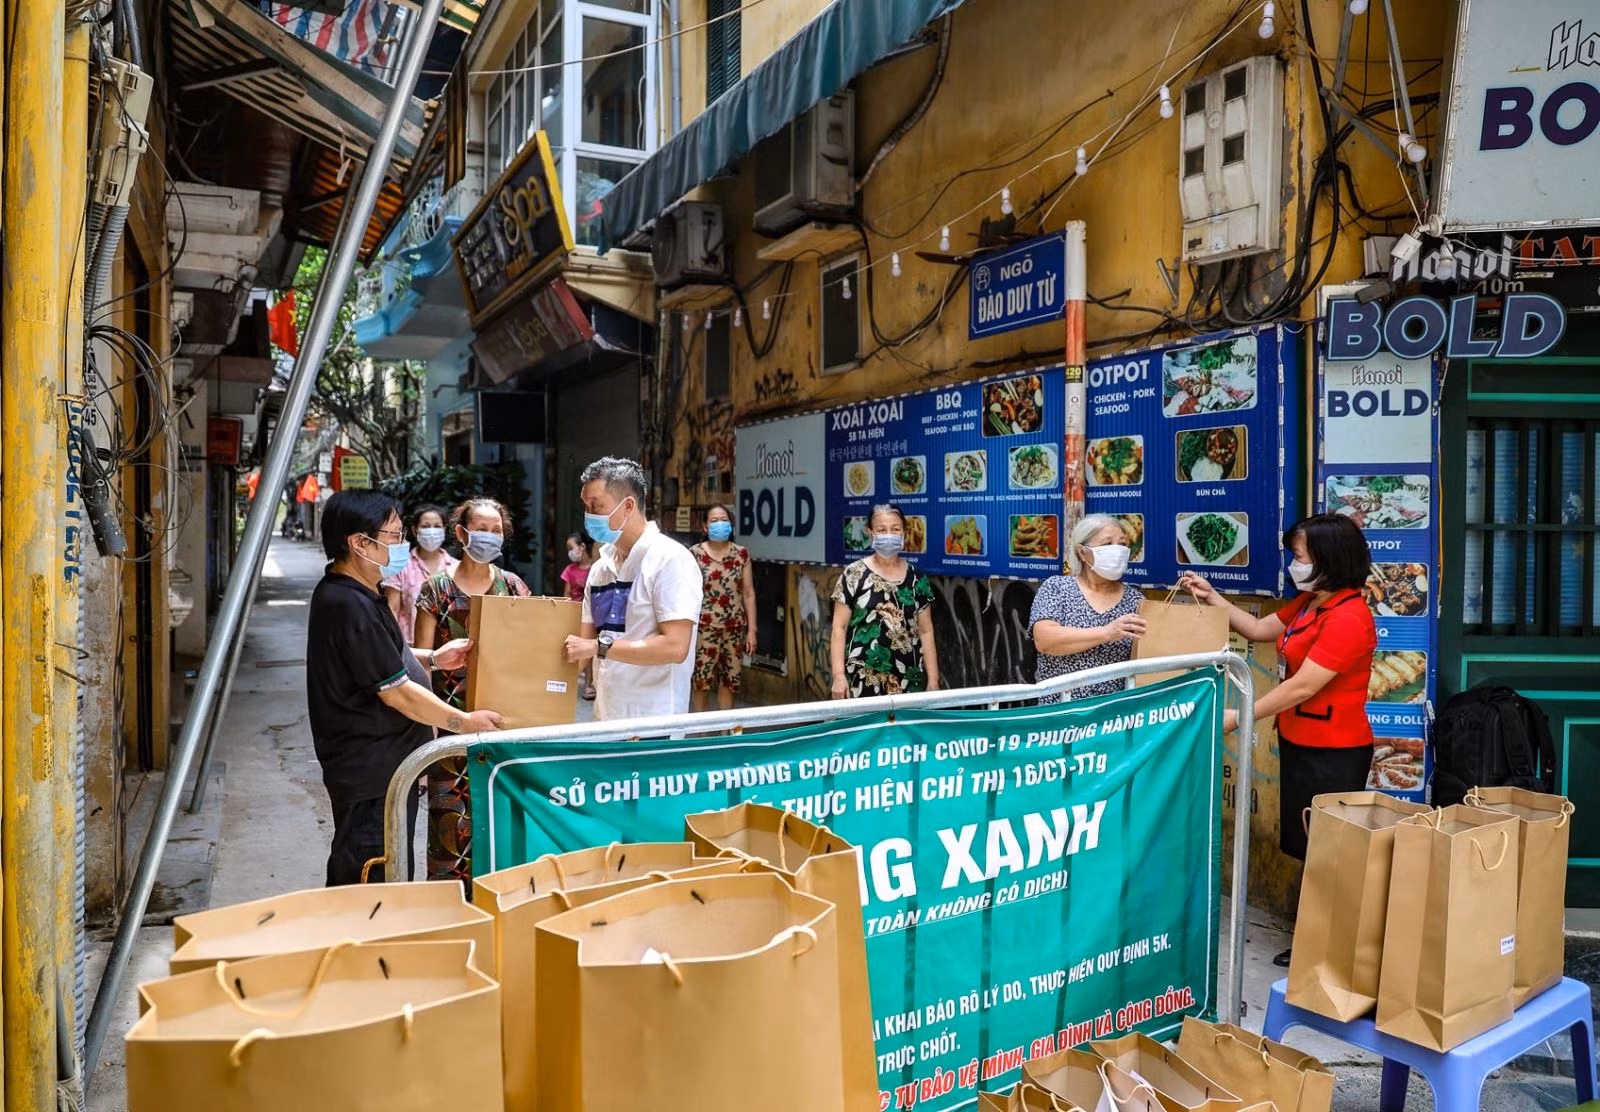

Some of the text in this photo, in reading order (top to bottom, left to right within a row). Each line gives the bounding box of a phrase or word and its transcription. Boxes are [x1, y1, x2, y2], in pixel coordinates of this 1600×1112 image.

[978, 270, 1057, 324] ĐÀO DUY TỪ
[1327, 292, 1567, 361] BOLD
[1085, 359, 1150, 388] OTPOT
[1351, 364, 1403, 386] Hanoi
[936, 391, 962, 410] BBQ
[1093, 387, 1155, 404] CHICKEN PORK
[1095, 403, 1130, 415] SEAFOOD
[1327, 388, 1429, 418] BOLD
[832, 398, 904, 431] XOÀI XOÀI
[924, 425, 948, 436] SEAFOOD
[936, 412, 959, 422] CHICKEN
[962, 409, 978, 418] PORK
[756, 440, 795, 480] Hanoi
[1086, 489, 1142, 498] VEGETARIAN NOODLE
[739, 486, 816, 537] BOLD
[1366, 541, 1401, 550] TPOT
[1210, 571, 1249, 581] VEGETABLES
[549, 777, 586, 808] SỞ
[595, 772, 640, 803] CHỈ
[649, 773, 698, 798] HUY
[708, 762, 791, 794] PHÒNG
[799, 747, 871, 780] CHỐNG
[877, 744, 927, 770] DỊCH
[935, 736, 1020, 760] COVID-19
[1025, 724, 1097, 750] PHƯỜNG
[1101, 714, 1144, 735] HÀNG
[782, 790, 846, 823] THỰC
[855, 778, 914, 814] HIỆN
[921, 768, 963, 801] CHỈ
[971, 767, 1006, 796] THỊ
[1013, 753, 1107, 788] 16/CT-TTg
[936, 800, 1107, 889] XANH
[867, 908, 921, 936] TOÀN
[925, 892, 992, 922] KHÔNG
[996, 881, 1019, 904] CÓ
[884, 1009, 921, 1038] KHAI
[926, 998, 955, 1026] BÁO
[960, 989, 979, 1014] RÕ
[983, 988, 1000, 1010] LÝ
[1003, 981, 1026, 1003] DO,
[1030, 970, 1065, 995] THỰC
[1068, 958, 1093, 984] HIỆN
[1098, 949, 1120, 973] QUY
[1123, 940, 1150, 964] ĐỊNH
[1153, 933, 1171, 952] 5K.
[877, 1027, 961, 1075] TRỰC CHỐT.
[895, 1079, 920, 1111] TỰ
[920, 1066, 955, 1103] BẢO
[959, 1059, 979, 1088] VỆ
[1030, 1035, 1055, 1062] GIA
[1058, 1022, 1092, 1051] ĐÌNH
[1095, 1013, 1113, 1037] VÀ
[1116, 998, 1152, 1031] CỘNG
[1154, 984, 1196, 1017] ĐỒNG.
